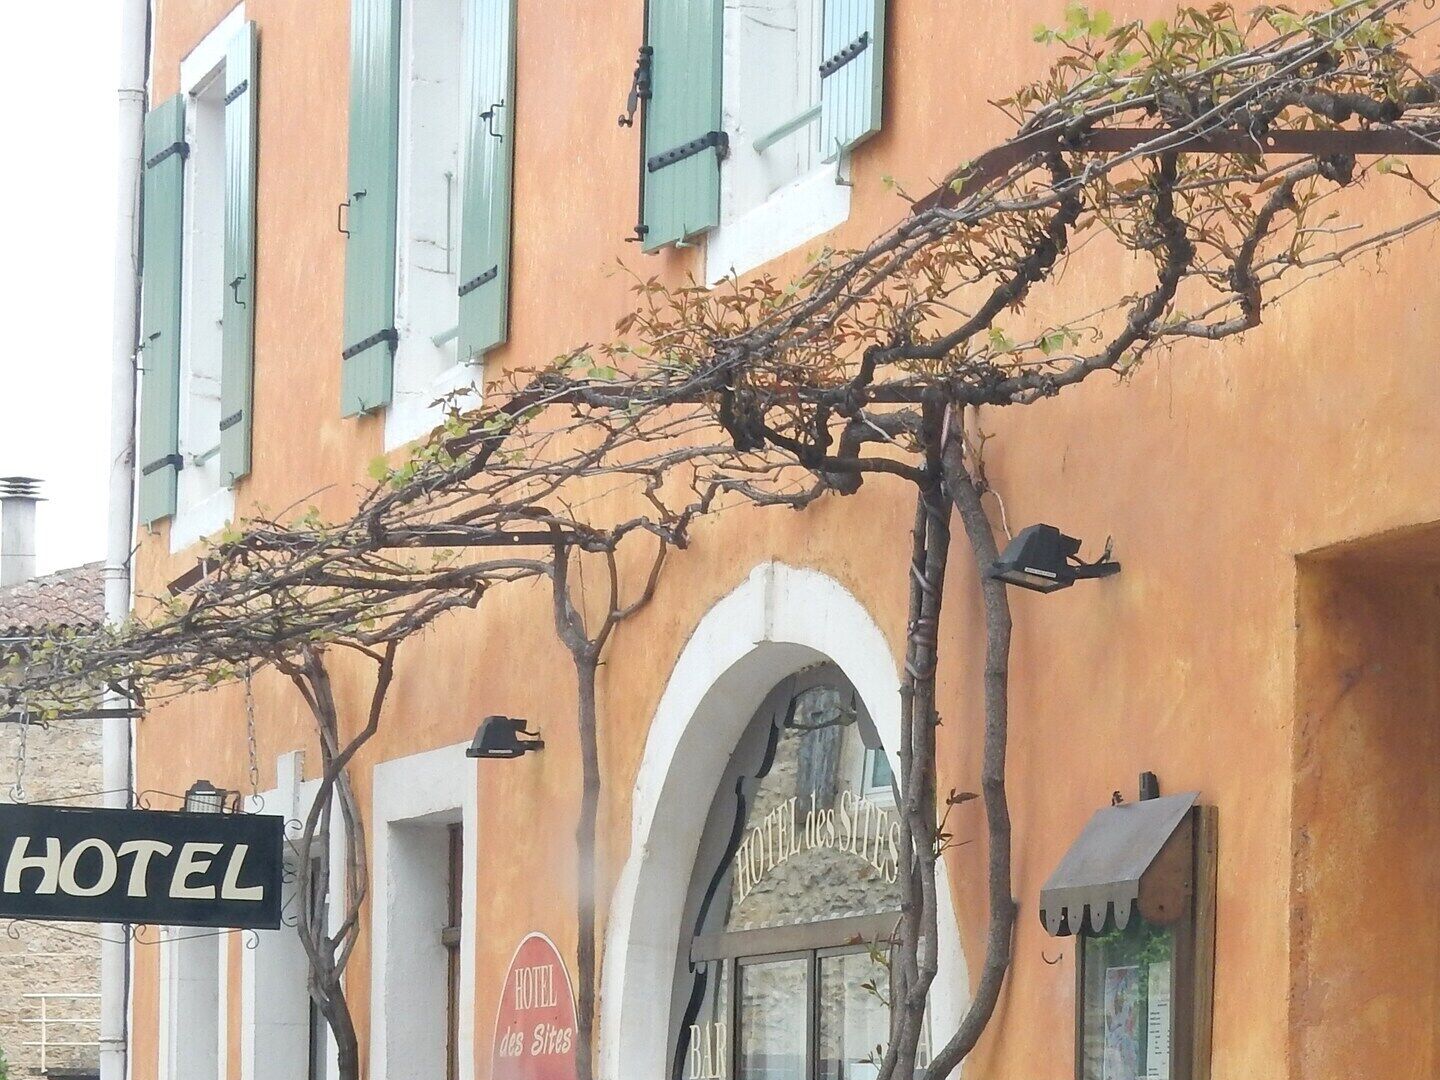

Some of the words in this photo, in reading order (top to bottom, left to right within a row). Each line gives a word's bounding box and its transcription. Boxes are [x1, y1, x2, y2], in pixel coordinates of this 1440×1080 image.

[4, 836, 264, 902] HOTEL
[736, 796, 802, 905] HOTEL
[805, 790, 835, 850] des
[839, 790, 901, 884] SITES
[514, 964, 557, 1010] HOTEL
[499, 1026, 524, 1057] des
[531, 1023, 572, 1057] Sites
[689, 1021, 727, 1080] BAR
